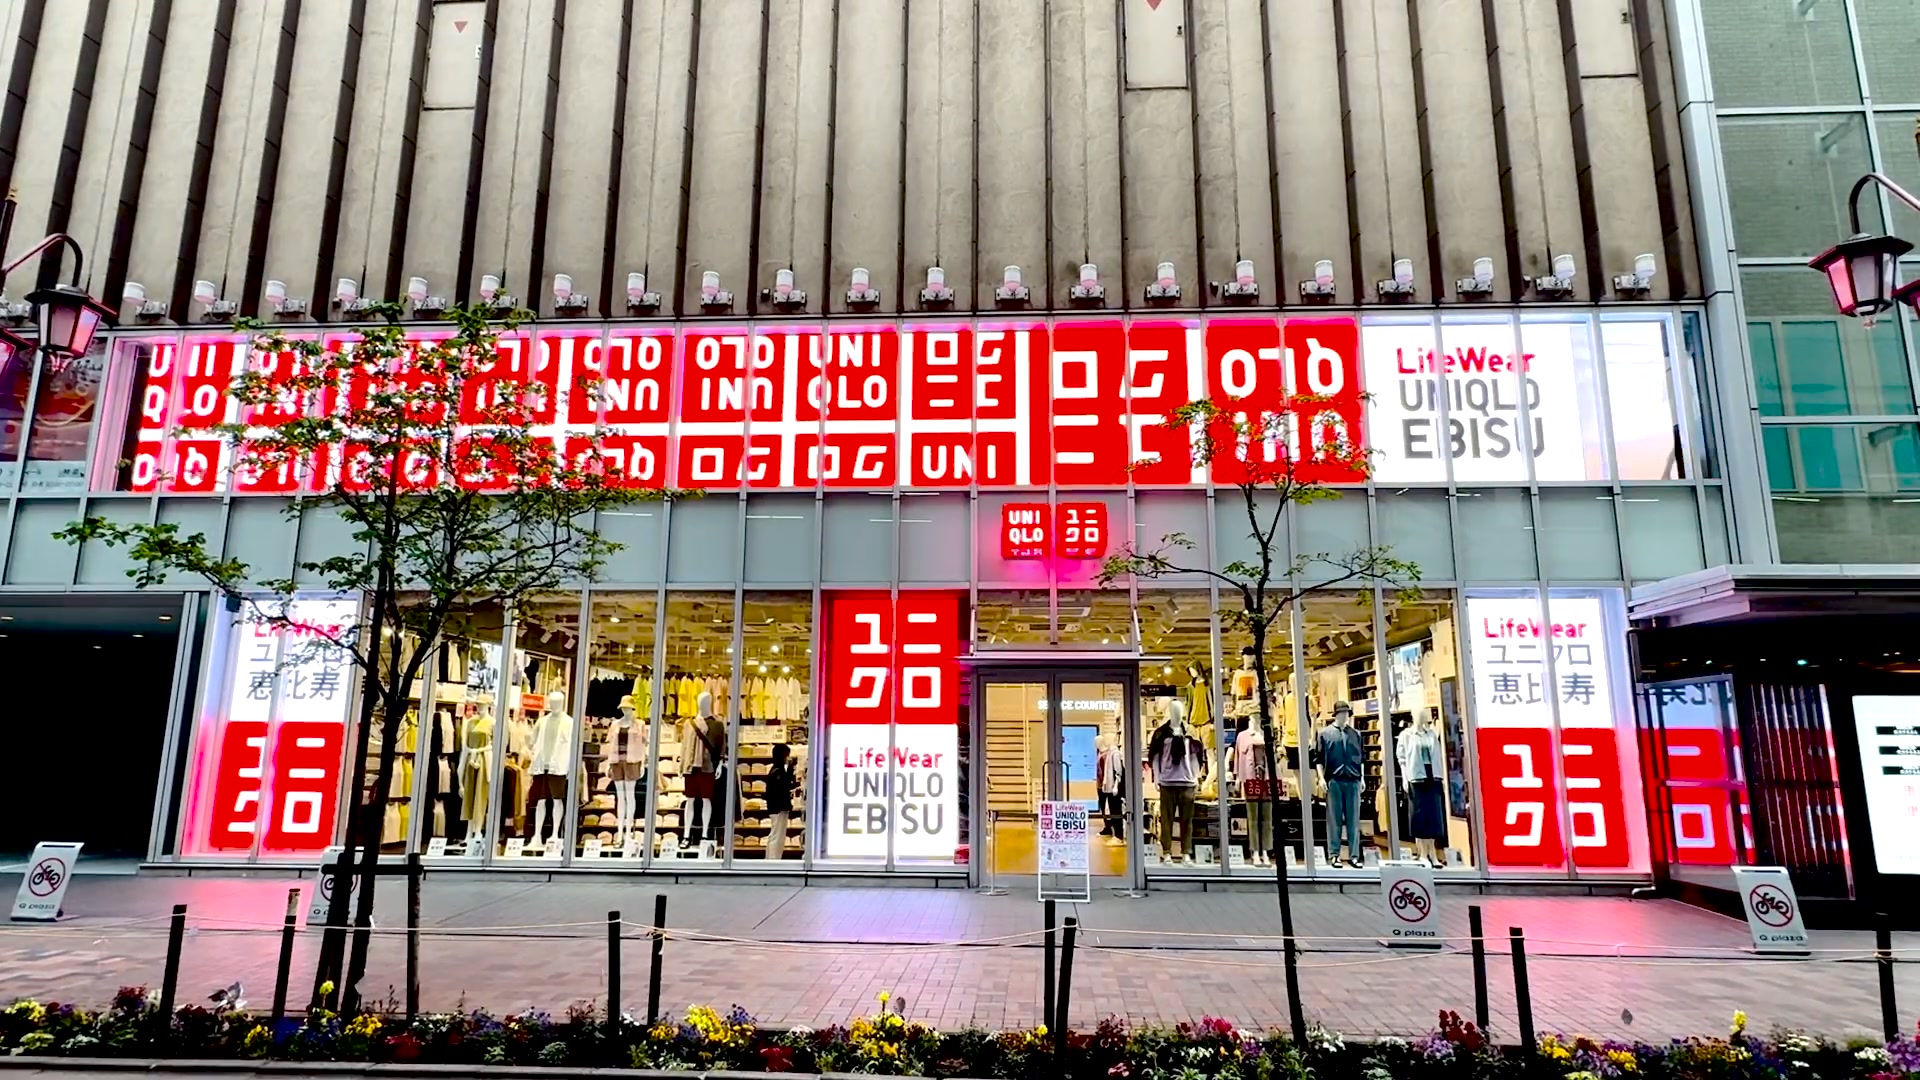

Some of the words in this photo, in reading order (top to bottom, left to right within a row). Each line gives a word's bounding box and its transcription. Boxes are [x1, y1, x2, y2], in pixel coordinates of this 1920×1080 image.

[808, 335, 881, 367] UNI
[807, 375, 888, 415] QLO
[1402, 417, 1545, 459] EBISU
[922, 444, 997, 479] UNI
[1008, 510, 1041, 525] UNI
[1009, 527, 1044, 545] QLO
[1055, 812, 1086, 820] UNIQLO
[1055, 820, 1086, 830] EBISU
